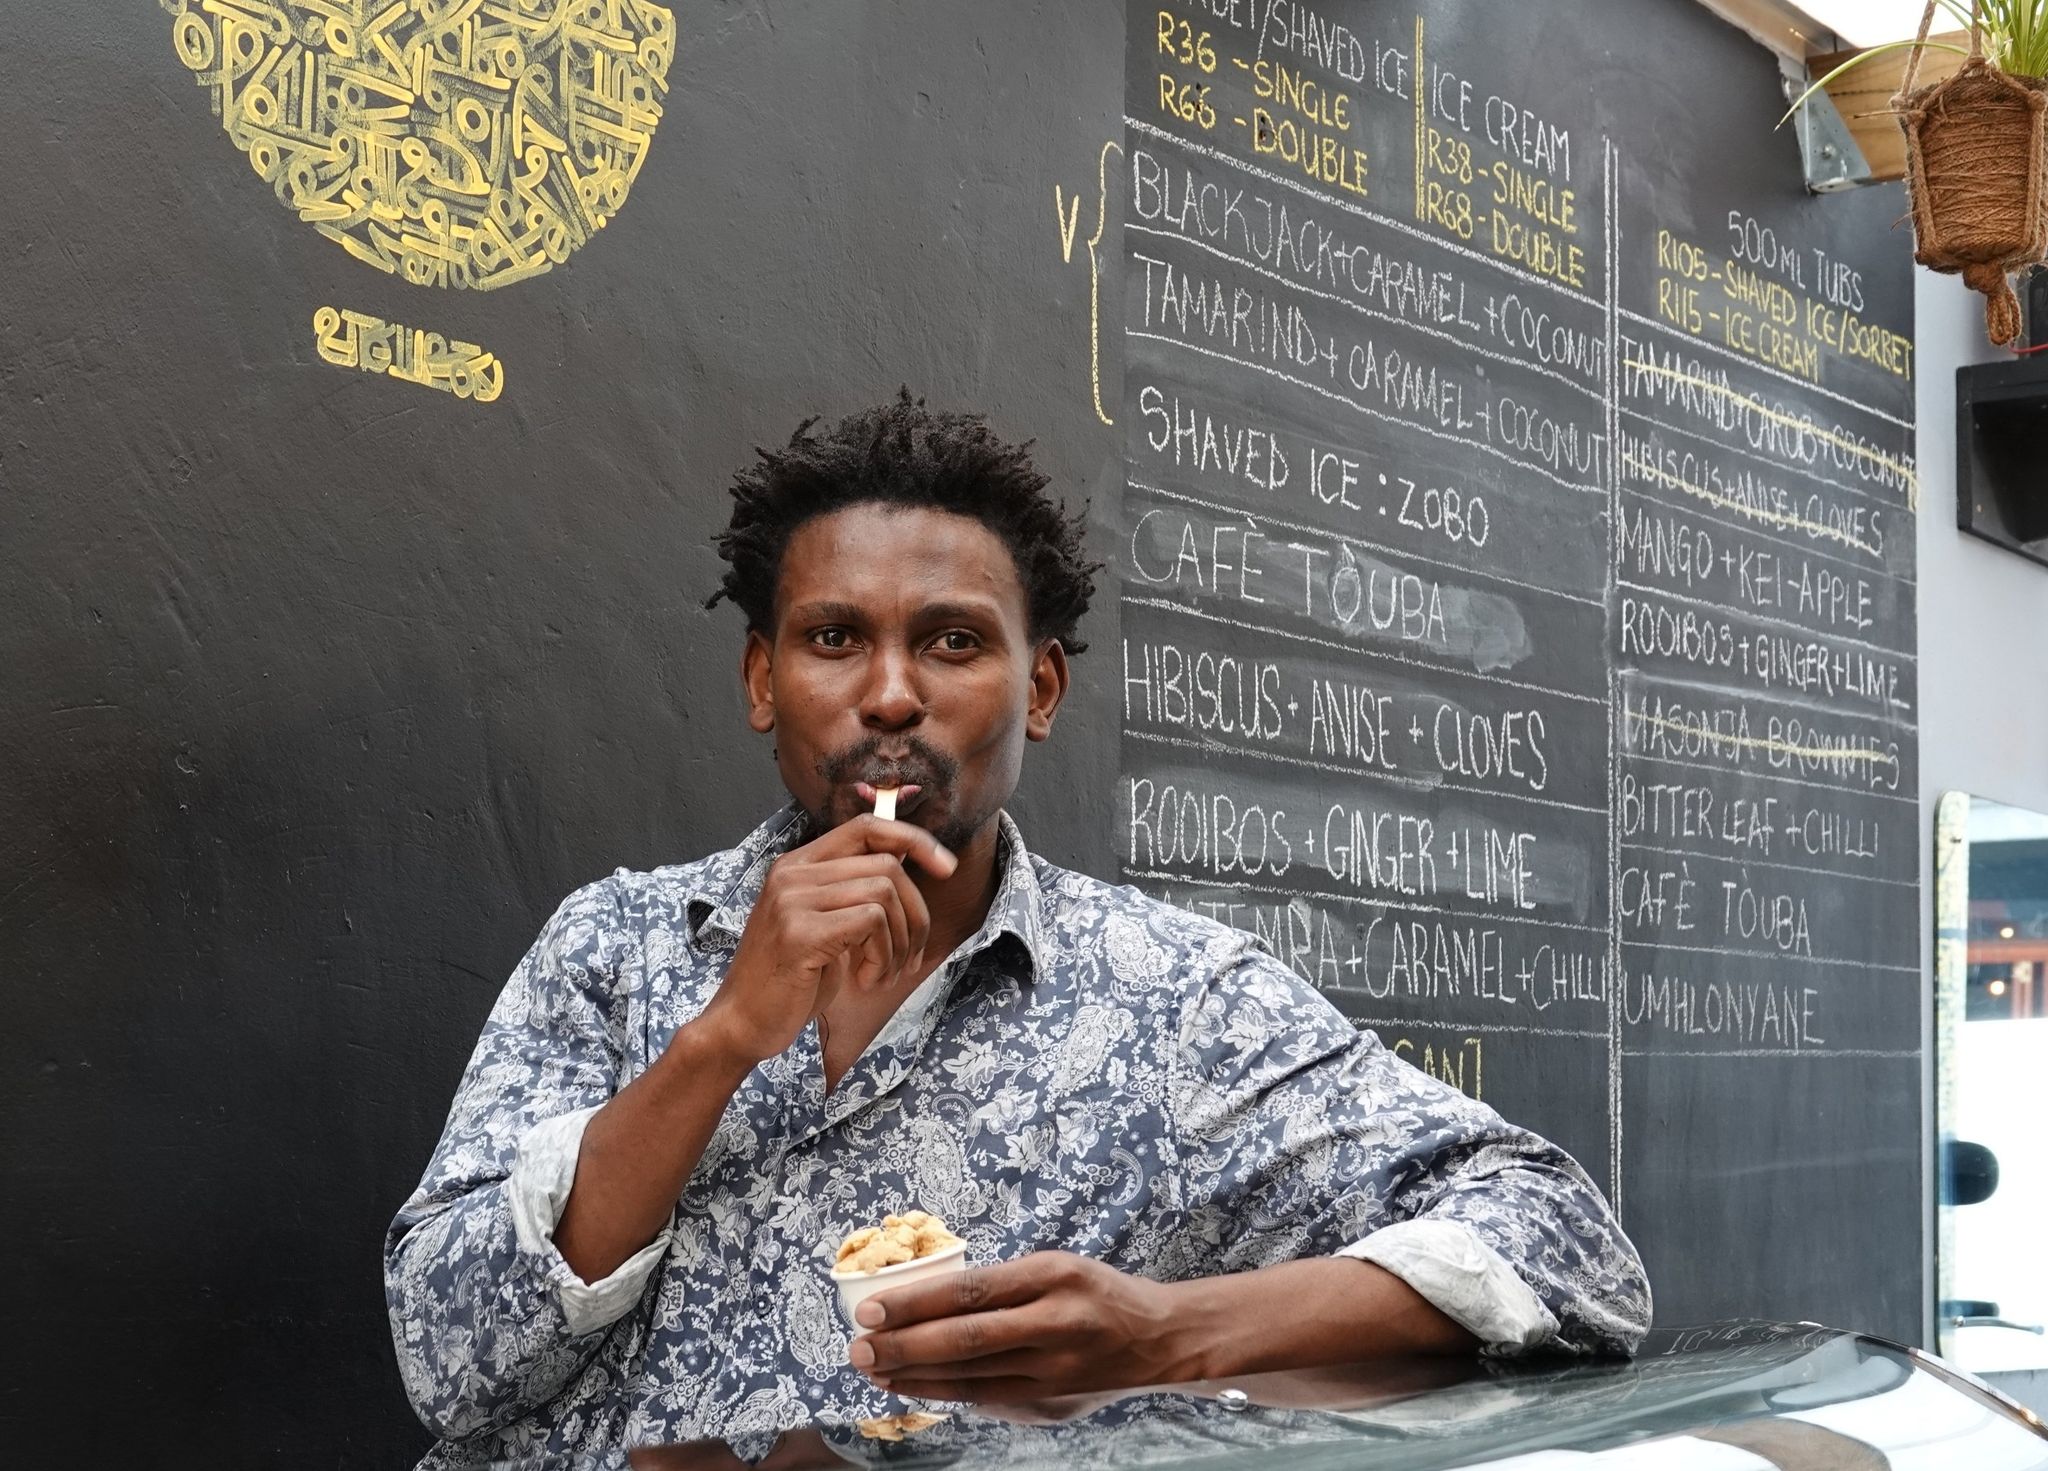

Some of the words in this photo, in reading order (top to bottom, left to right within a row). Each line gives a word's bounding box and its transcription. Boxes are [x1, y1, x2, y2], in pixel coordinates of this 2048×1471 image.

[1158, 11, 1217, 73] R36
[1254, 60, 1350, 130] SINGLE
[1375, 40, 1408, 99] ICE
[1432, 62, 1473, 131] ICE
[1485, 96, 1570, 181] CREAM
[1160, 74, 1217, 130] R66
[1254, 107, 1367, 195] DOUBLE
[1428, 128, 1473, 184] R38
[1493, 161, 1577, 233] SINGLE
[1428, 182, 1473, 239] R68
[1493, 208, 1585, 288] DOUBLE
[1659, 230, 1708, 281] R105
[1723, 259, 1797, 327] SHAVED
[1813, 248, 1864, 313] TUBS
[1660, 277, 1703, 334] R115
[1725, 306, 1756, 354] ICE
[1759, 322, 1820, 384] CREAM
[1349, 340, 1473, 430] CARAMEL
[1140, 386, 1290, 490] SHAVED
[1397, 477, 1490, 547] ZOBO
[1619, 504, 1714, 588] MANGO
[1123, 638, 1283, 741] HIBISCUS
[1310, 680, 1397, 769] ANISE
[1433, 705, 1548, 791] CLOVES
[1768, 716, 1900, 789] BROWNIES
[1130, 778, 1293, 877] ROOIBOS
[1324, 804, 1437, 896] GINGER
[1623, 774, 1714, 839] BITTER
[1723, 798, 1777, 855] LEAF
[1623, 971, 1825, 1055] UMHLONYANE
